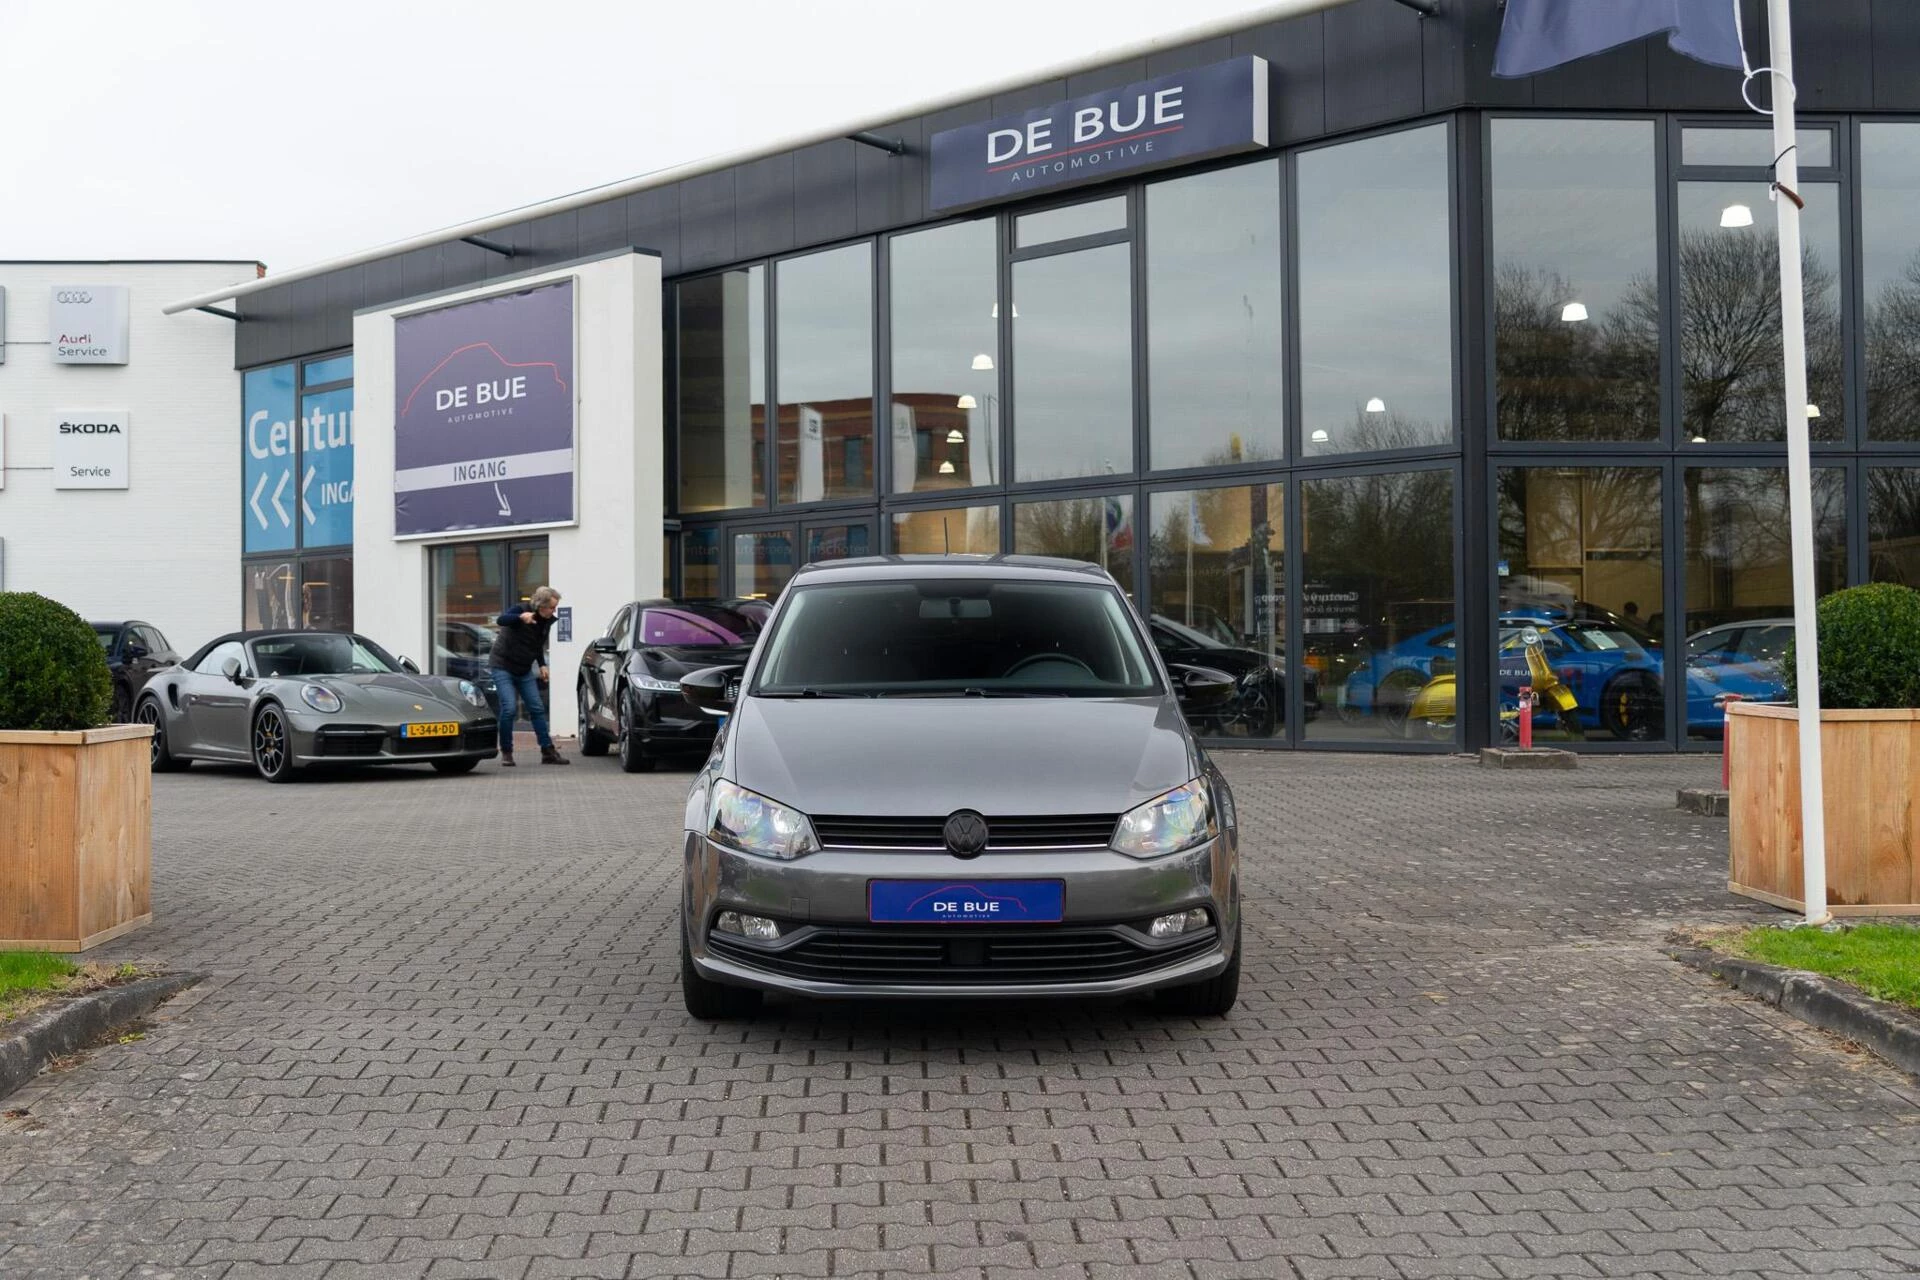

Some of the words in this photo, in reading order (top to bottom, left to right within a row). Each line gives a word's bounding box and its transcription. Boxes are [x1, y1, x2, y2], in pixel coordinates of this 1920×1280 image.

[988, 118, 1052, 164] DE
[1074, 86, 1184, 143] BUE
[1011, 141, 1154, 183] AUTOMOTIVE
[59, 333, 91, 344] Audi
[58, 346, 107, 356] Service
[435, 386, 467, 411] DE
[476, 376, 526, 404] BUE
[447, 407, 514, 424] AUTOMOTIVE
[59, 422, 121, 434] ŠKODA
[70, 465, 111, 477] Service
[453, 460, 507, 482] INGANG
[410, 724, 456, 736] L-344-DD
[933, 902, 958, 912] DE
[964, 902, 1000, 912] BUE
